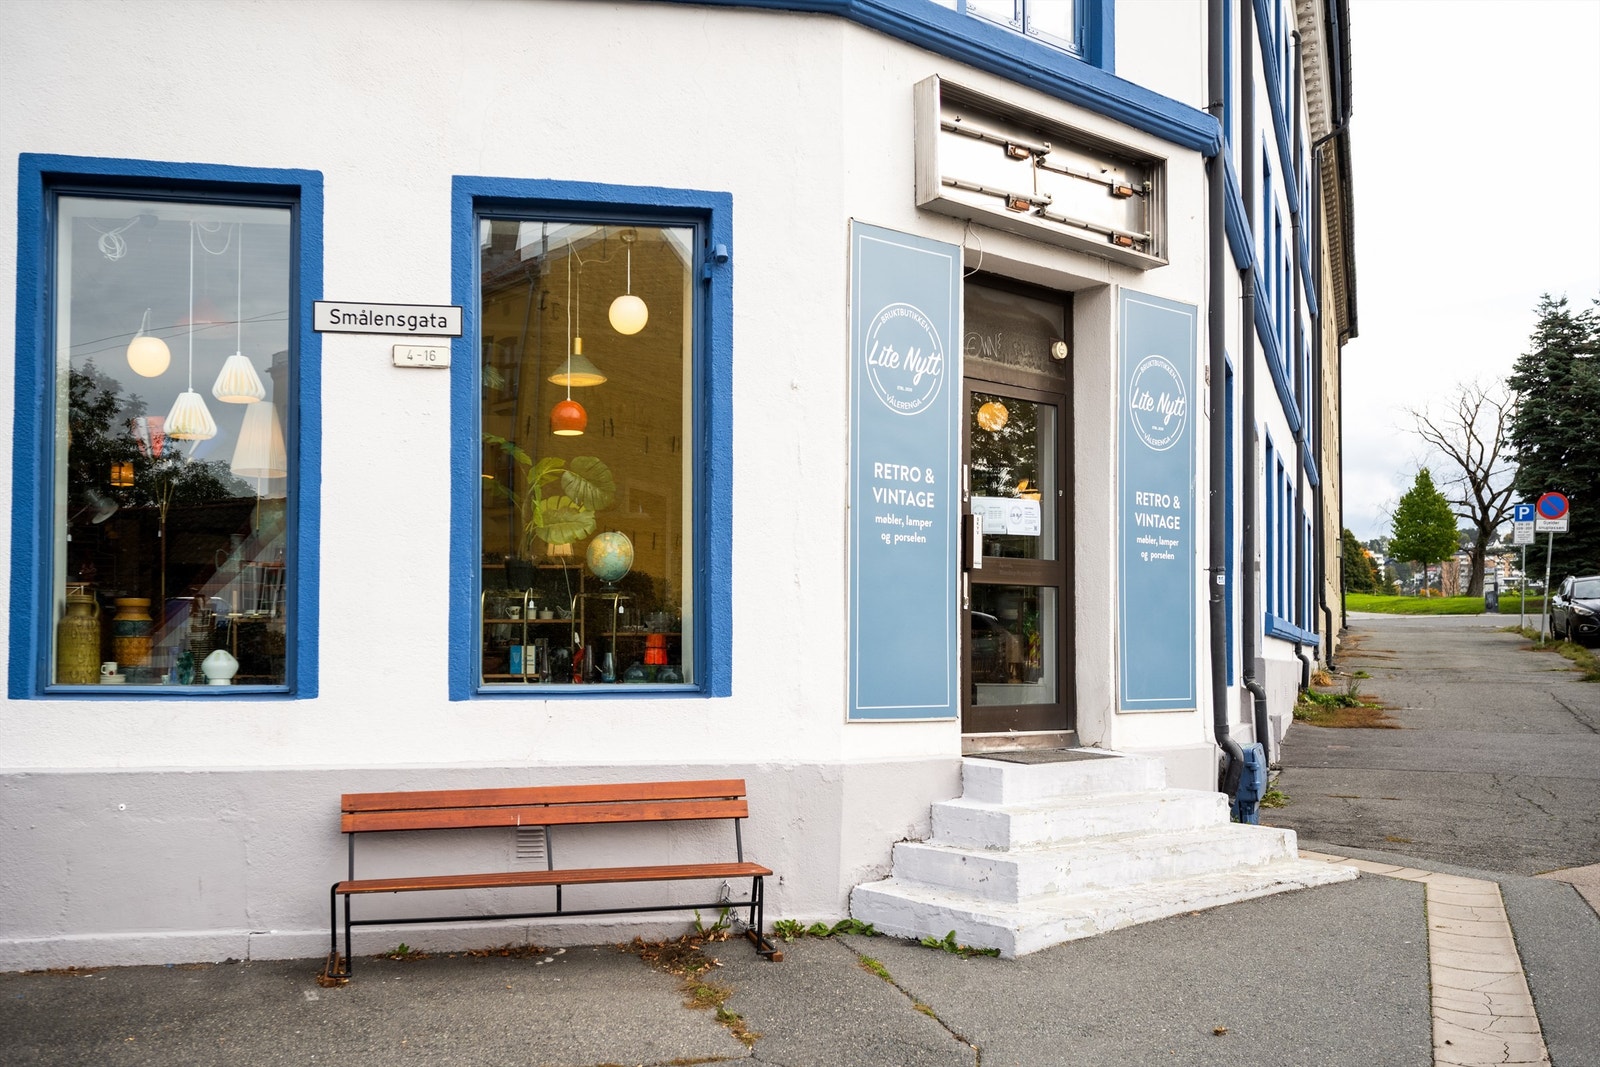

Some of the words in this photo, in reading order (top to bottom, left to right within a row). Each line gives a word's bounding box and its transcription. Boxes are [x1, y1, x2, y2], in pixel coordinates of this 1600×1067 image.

[330, 308, 447, 331] Smålensgata
[880, 308, 930, 332] BRUKTBUTIKKEN
[869, 340, 900, 369] Lite
[903, 346, 941, 386] Nytt
[886, 394, 922, 410] VÅLERENGA
[1132, 387, 1154, 412] Lite
[1156, 392, 1185, 426] Nytt
[874, 462, 921, 483] RETRO
[925, 468, 935, 484] &
[872, 486, 935, 508] VINTAGE
[1135, 491, 1170, 508] RETRO
[1172, 495, 1180, 509] &
[875, 513, 904, 528] møbler,
[905, 515, 932, 531] lamper
[1134, 512, 1180, 530] VINTAGE
[1519, 506, 1530, 520] P
[881, 533, 891, 545] og
[894, 532, 926, 545] porselen
[1136, 534, 1158, 547] møbler,
[1158, 535, 1179, 549] lamper
[1140, 551, 1149, 561] og
[1150, 550, 1175, 562] porselen
